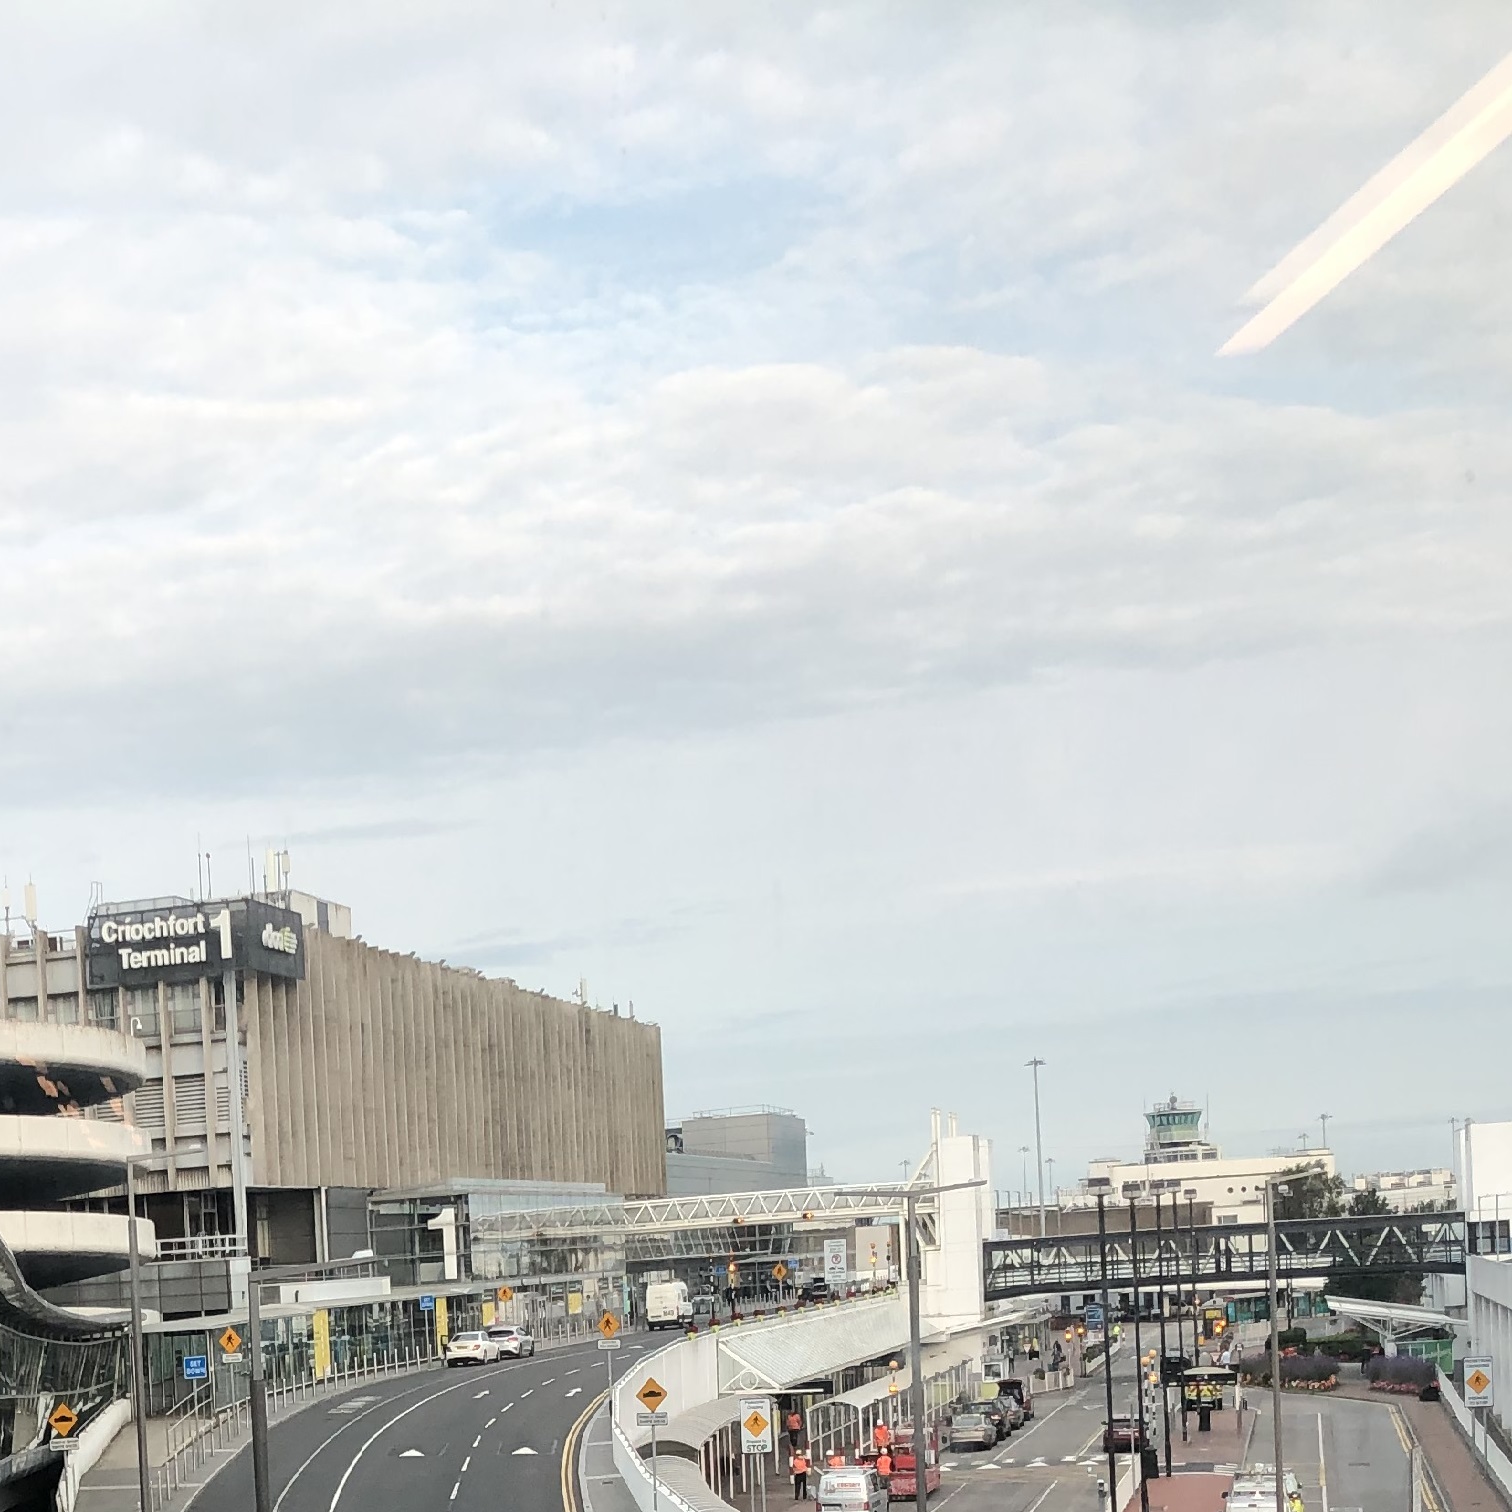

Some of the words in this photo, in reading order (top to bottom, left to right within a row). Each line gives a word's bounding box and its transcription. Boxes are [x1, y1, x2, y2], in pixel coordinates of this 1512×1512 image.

[101, 913, 206, 943] Críochfort
[210, 908, 233, 960] 1
[118, 940, 207, 970] Terminal
[427, 1208, 457, 1280] 1
[746, 1443, 768, 1452] STOP
